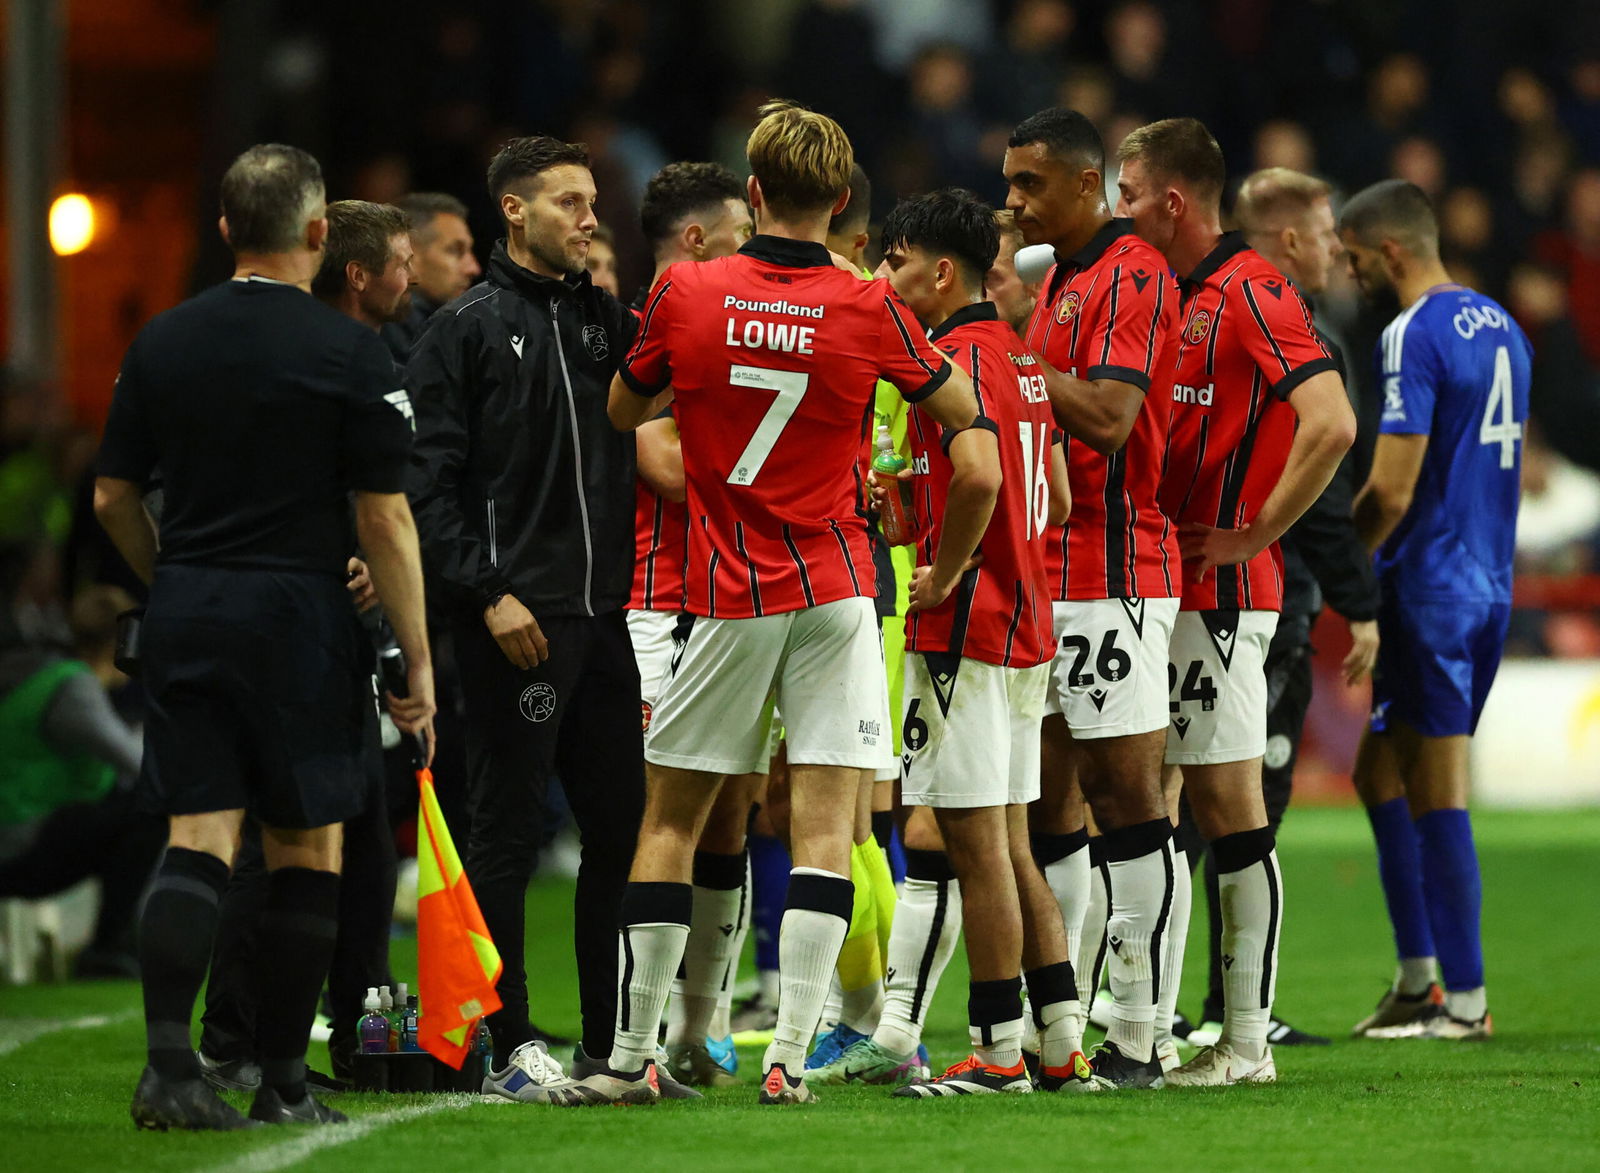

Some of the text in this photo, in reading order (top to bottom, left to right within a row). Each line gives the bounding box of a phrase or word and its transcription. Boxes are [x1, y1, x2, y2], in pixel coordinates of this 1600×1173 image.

[723, 295, 825, 319] Poundland
[726, 317, 816, 355] LOWE
[726, 364, 809, 486] 7
[1479, 345, 1522, 469] 4
[1018, 421, 1050, 541] 16
[1062, 629, 1131, 687] 26
[903, 698, 928, 751] 6
